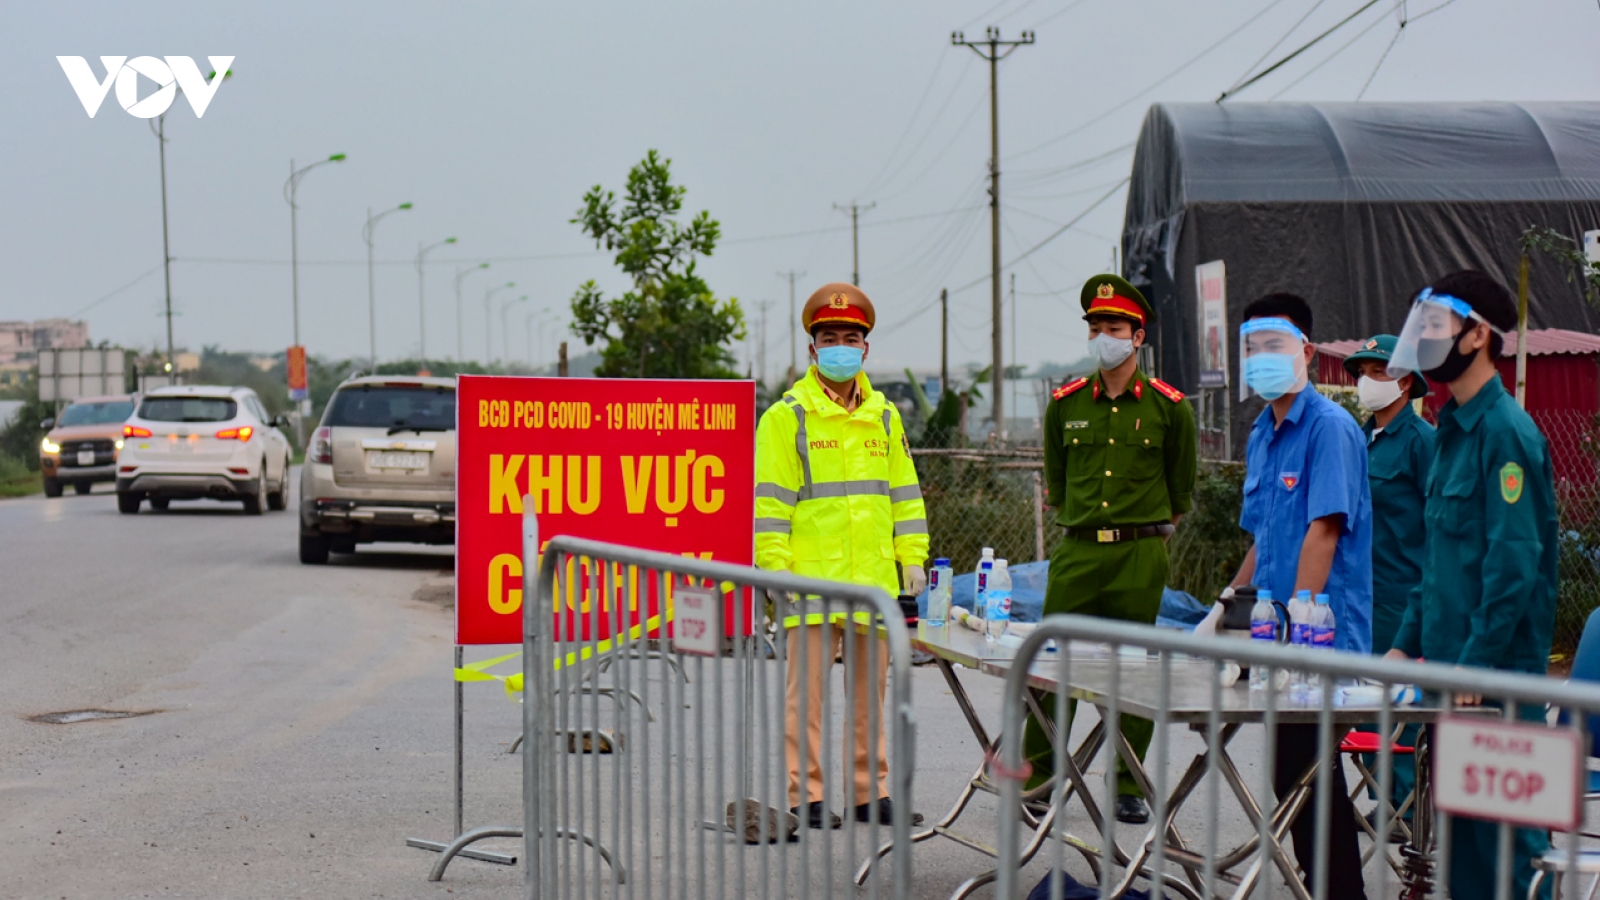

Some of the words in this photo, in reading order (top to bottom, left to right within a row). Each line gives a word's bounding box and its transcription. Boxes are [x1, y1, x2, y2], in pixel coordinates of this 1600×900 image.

[478, 399, 510, 428] BCĐ
[513, 400, 544, 429] PCD
[548, 401, 591, 429] COVID
[605, 402, 623, 430] 19
[626, 397, 674, 436] HUYỆN
[678, 397, 700, 430] MÊ
[703, 403, 736, 430] LINH
[809, 439, 839, 450] POLICE
[488, 454, 602, 515] KHU
[620, 449, 725, 527] VỰC
[1463, 764, 1545, 802] STOP
